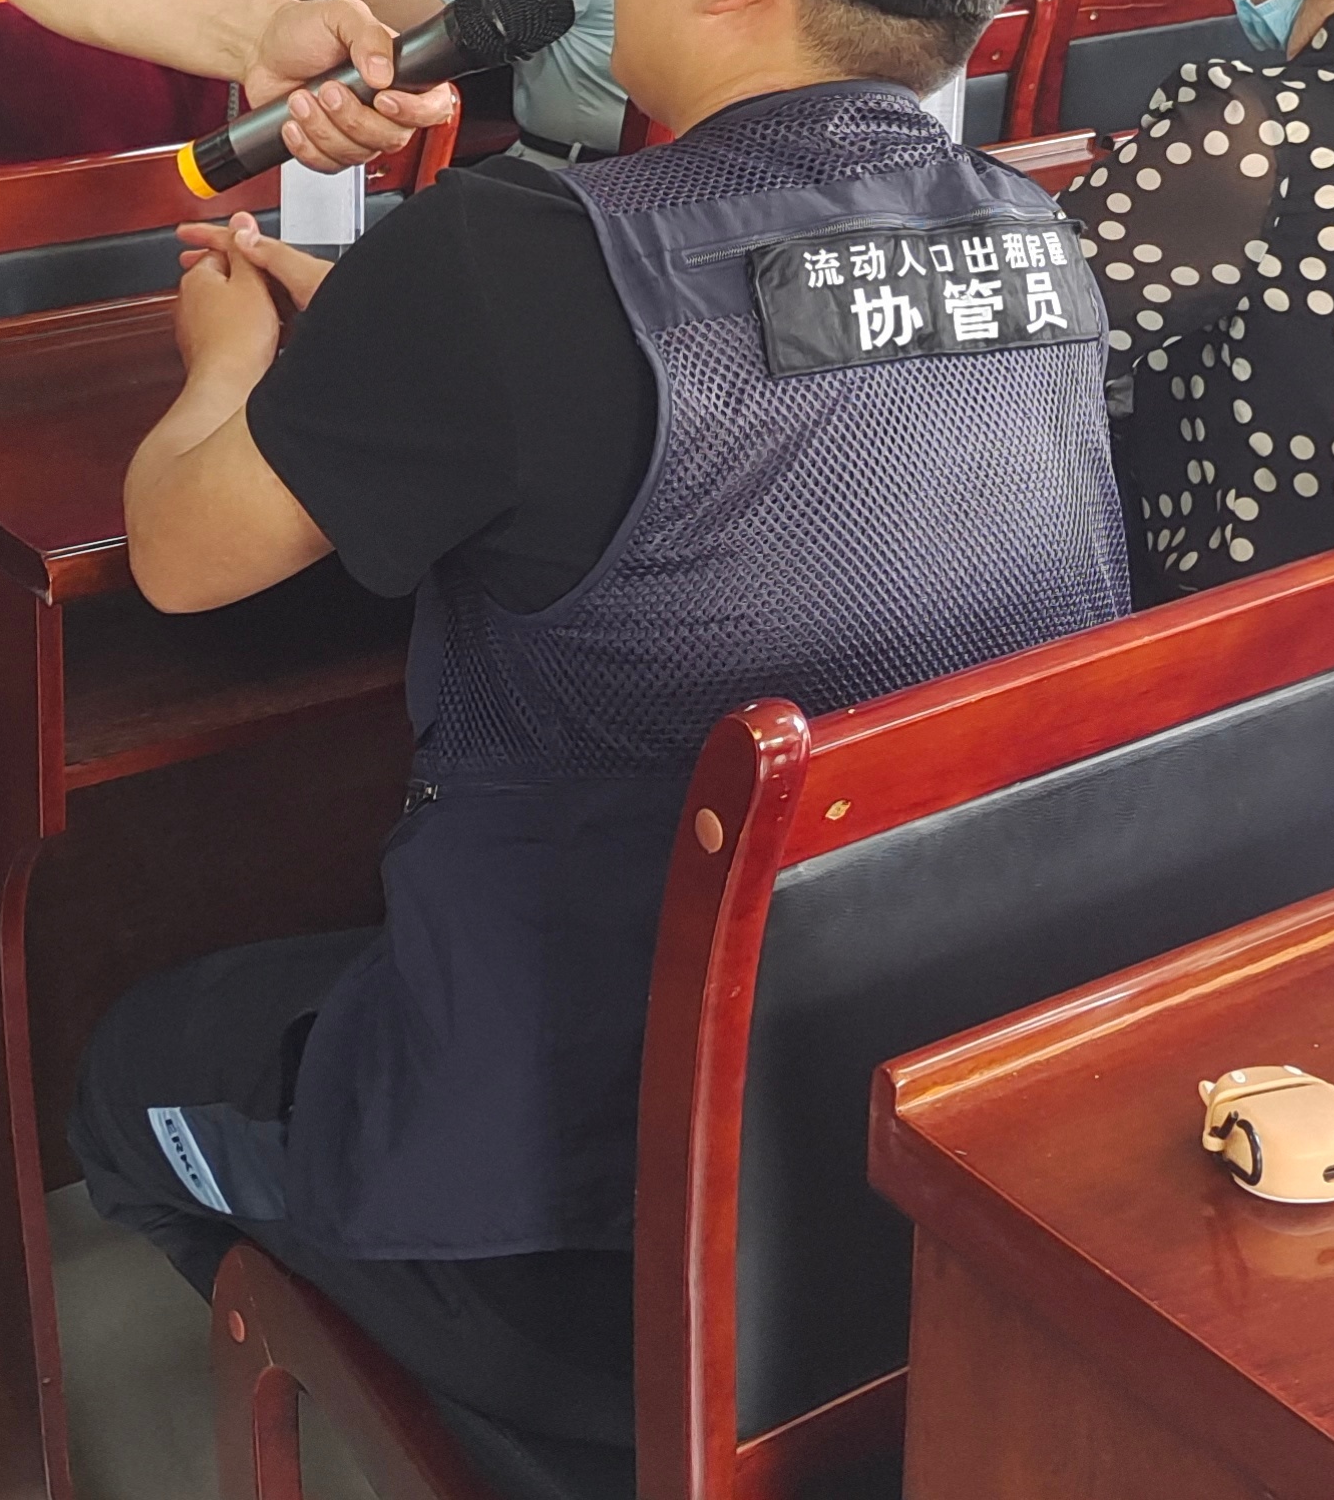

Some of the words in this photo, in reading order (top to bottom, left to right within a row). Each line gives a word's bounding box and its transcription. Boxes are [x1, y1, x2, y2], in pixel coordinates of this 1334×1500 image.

[802, 231, 1068, 289] 流动人口出租房屋
[851, 271, 1068, 352] 协管员
